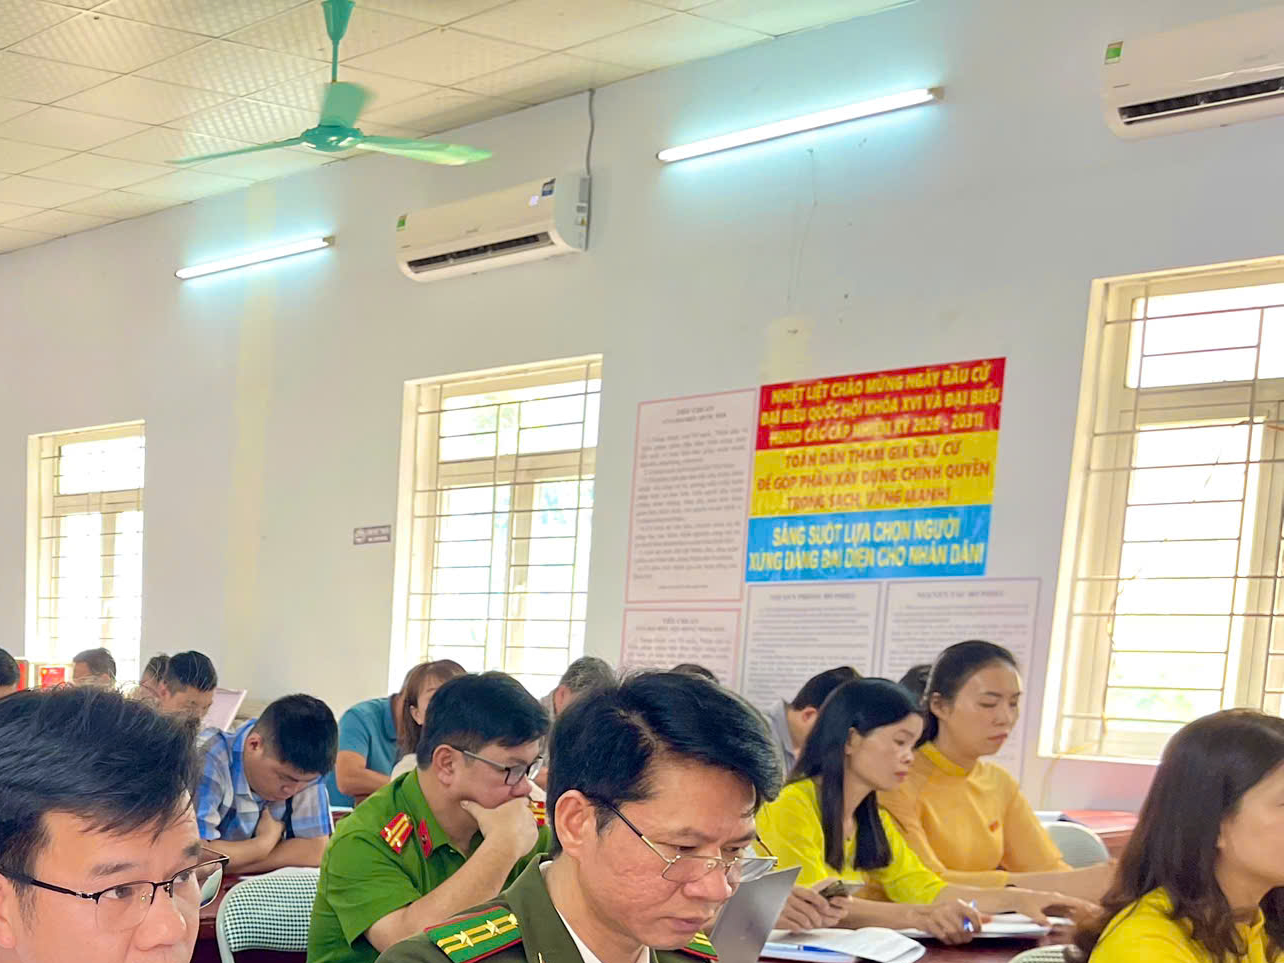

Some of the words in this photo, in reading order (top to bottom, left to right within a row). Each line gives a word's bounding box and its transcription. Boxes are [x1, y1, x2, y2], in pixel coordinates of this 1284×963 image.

[831, 377, 863, 397] CHÀO
[866, 374, 903, 392] MỪNG
[906, 371, 940, 388] NGÀY
[943, 365, 967, 385] BẦU
[971, 361, 992, 381] CỬ
[809, 400, 840, 421] QUỐC
[841, 402, 863, 417] HỘI
[903, 395, 923, 411] XVI
[925, 389, 941, 409] VÀ
[970, 382, 999, 404] BIỂU
[786, 451, 817, 468] TOÀN
[820, 447, 845, 466] DÂN
[849, 446, 884, 464] THAM
[889, 444, 909, 461] GIA
[799, 470, 832, 488] PHẦN
[836, 468, 858, 485] XÂY
[901, 462, 942, 481] CHÍNH
[946, 457, 990, 478] QUYỀN
[788, 494, 825, 510] TRONG
[773, 522, 806, 546] SÁNG
[808, 521, 841, 544] SUỐT
[844, 523, 871, 547] LỰA
[874, 520, 911, 546] CHỌN
[878, 548, 906, 568] CHO
[909, 542, 949, 565] NHÂN
